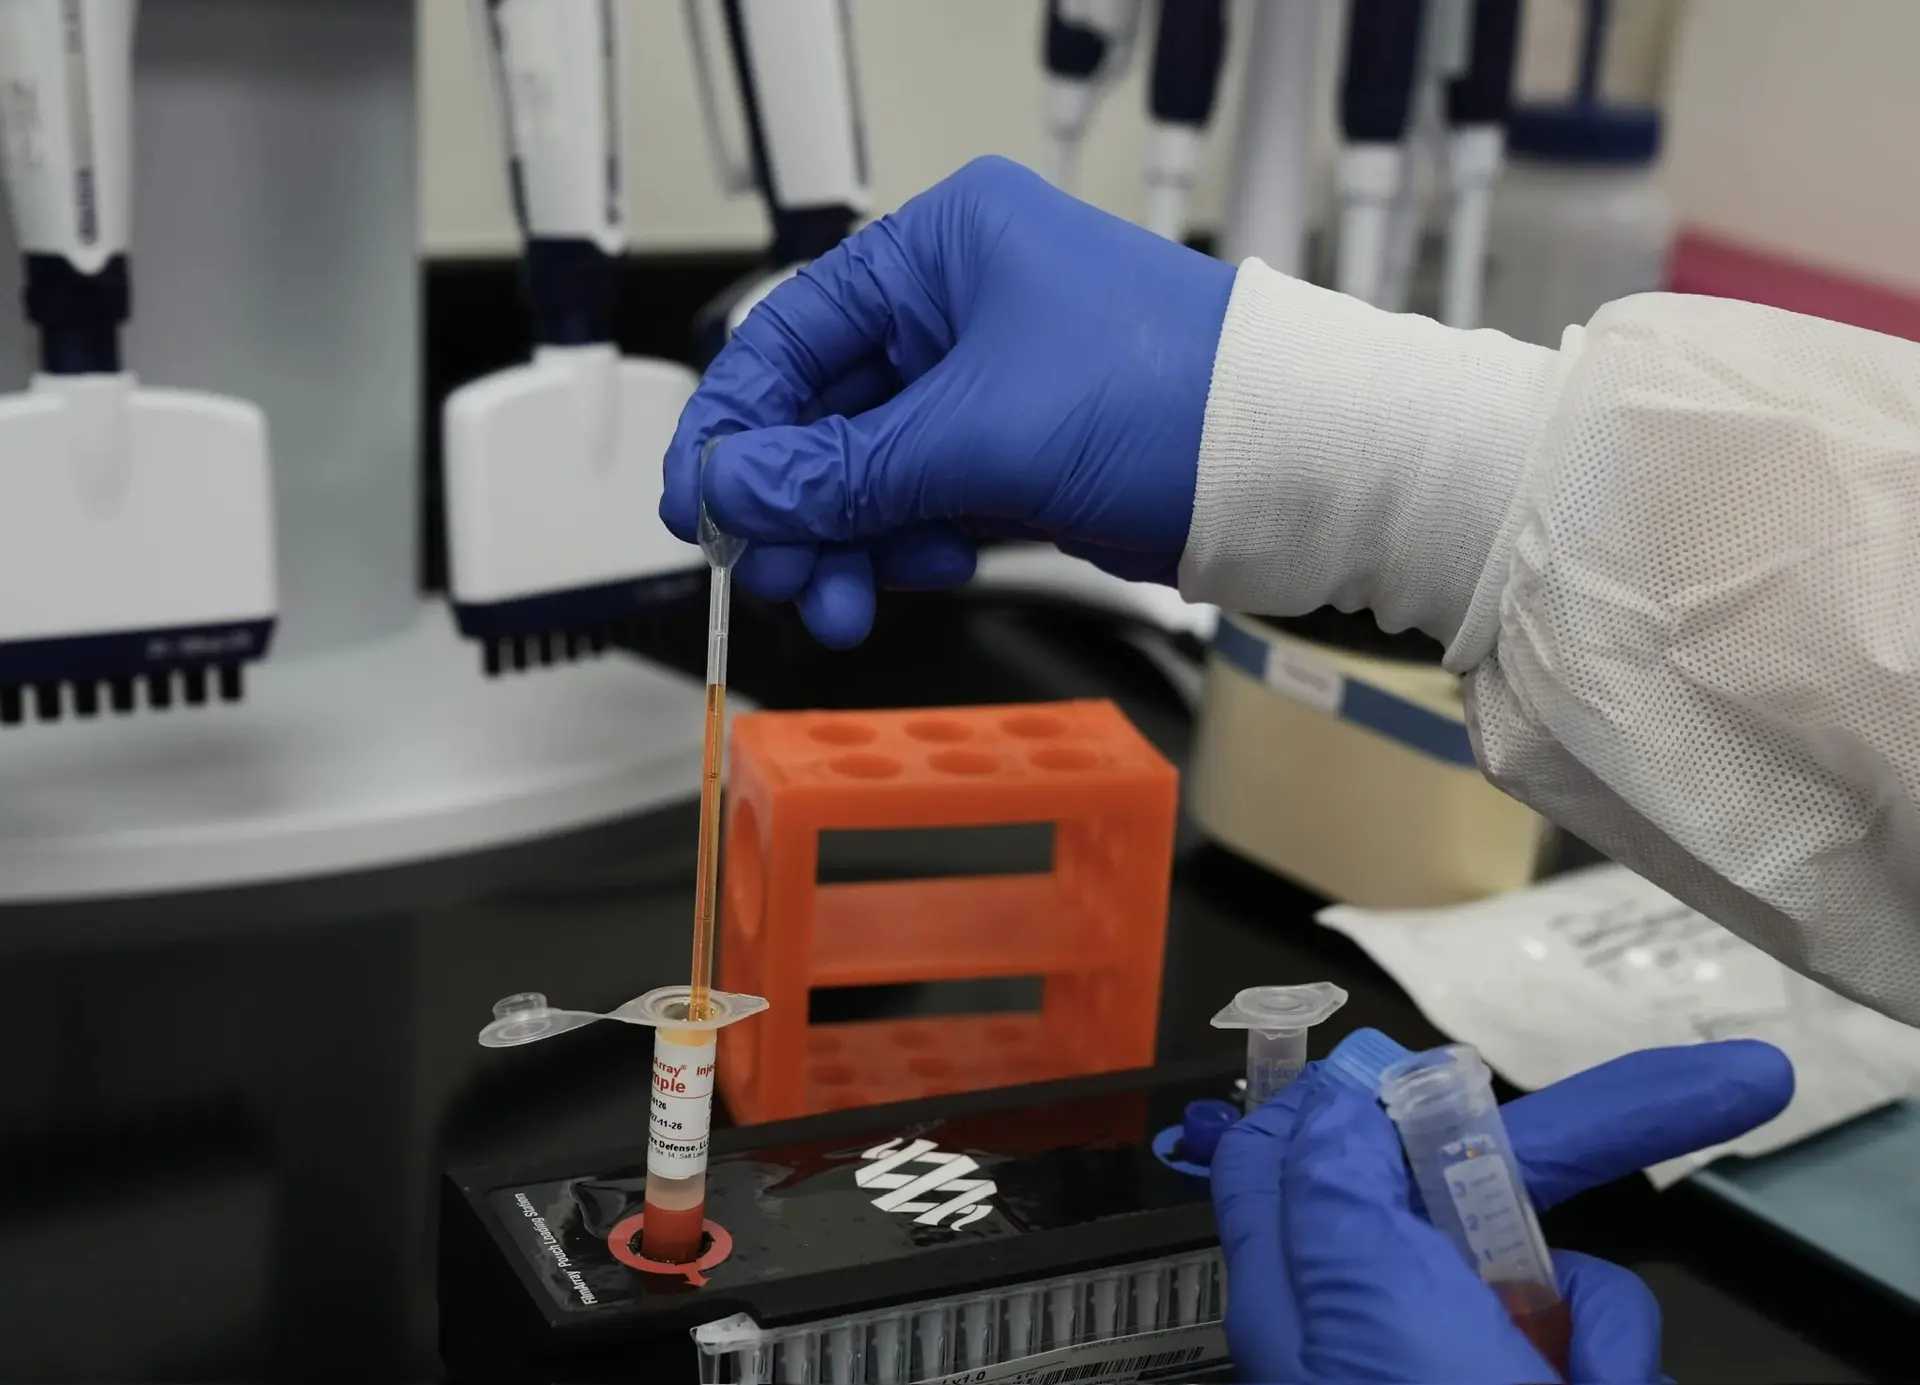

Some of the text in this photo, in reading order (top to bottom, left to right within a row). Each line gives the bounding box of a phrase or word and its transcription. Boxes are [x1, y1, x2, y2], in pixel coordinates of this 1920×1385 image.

[515, 1192, 538, 1218] Station
[532, 1217, 557, 1245] Loading
[548, 1244, 572, 1268] Pouch
